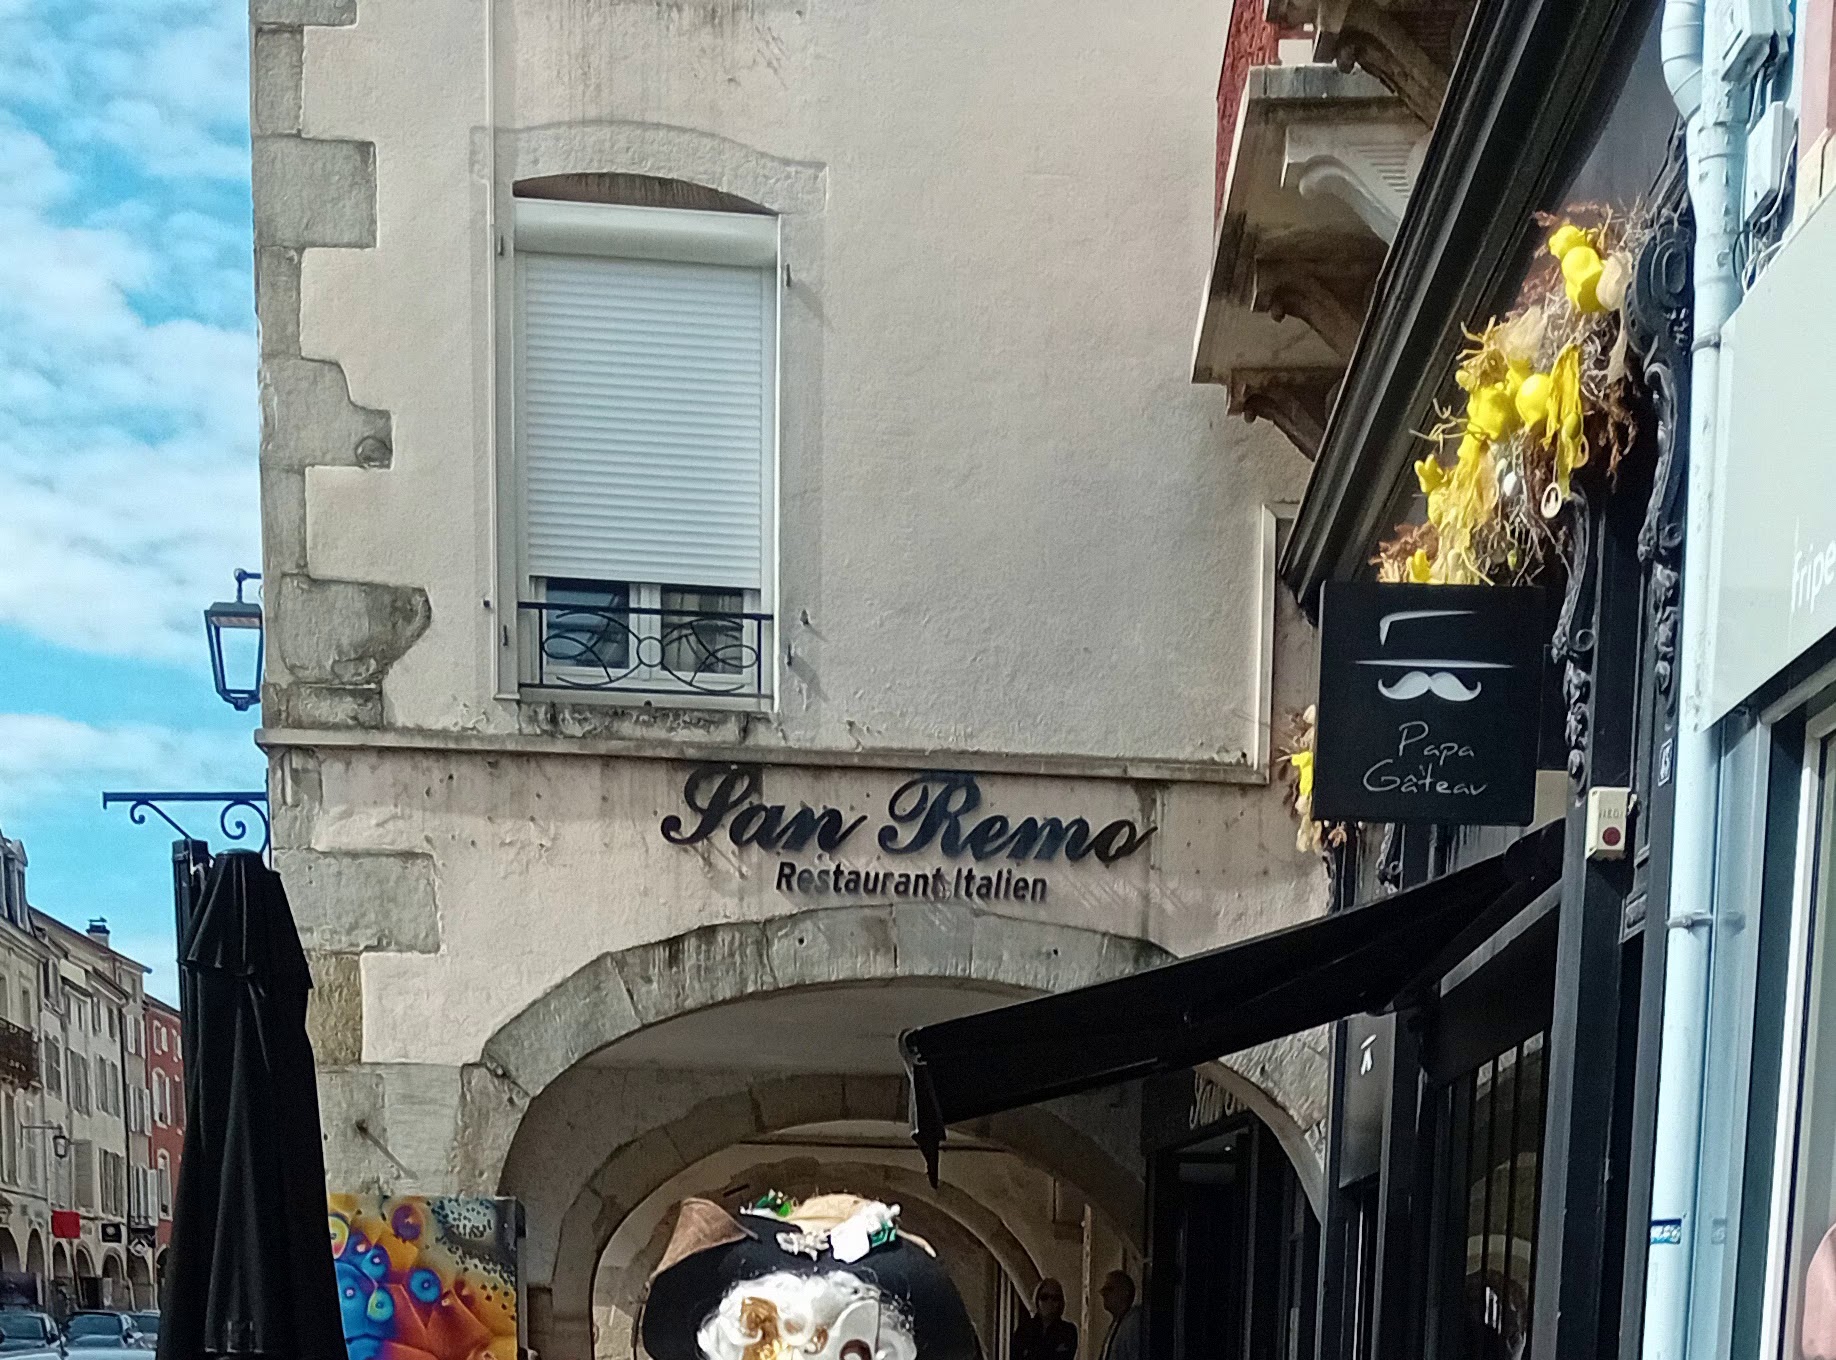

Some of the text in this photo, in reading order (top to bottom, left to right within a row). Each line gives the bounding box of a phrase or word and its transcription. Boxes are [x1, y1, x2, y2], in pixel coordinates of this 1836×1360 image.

[1398, 720, 1475, 766] Papa
[1362, 758, 1489, 797] Gâteau
[660, 763, 1159, 863] San Remo
[775, 860, 1048, 904] Restaurant Italien
